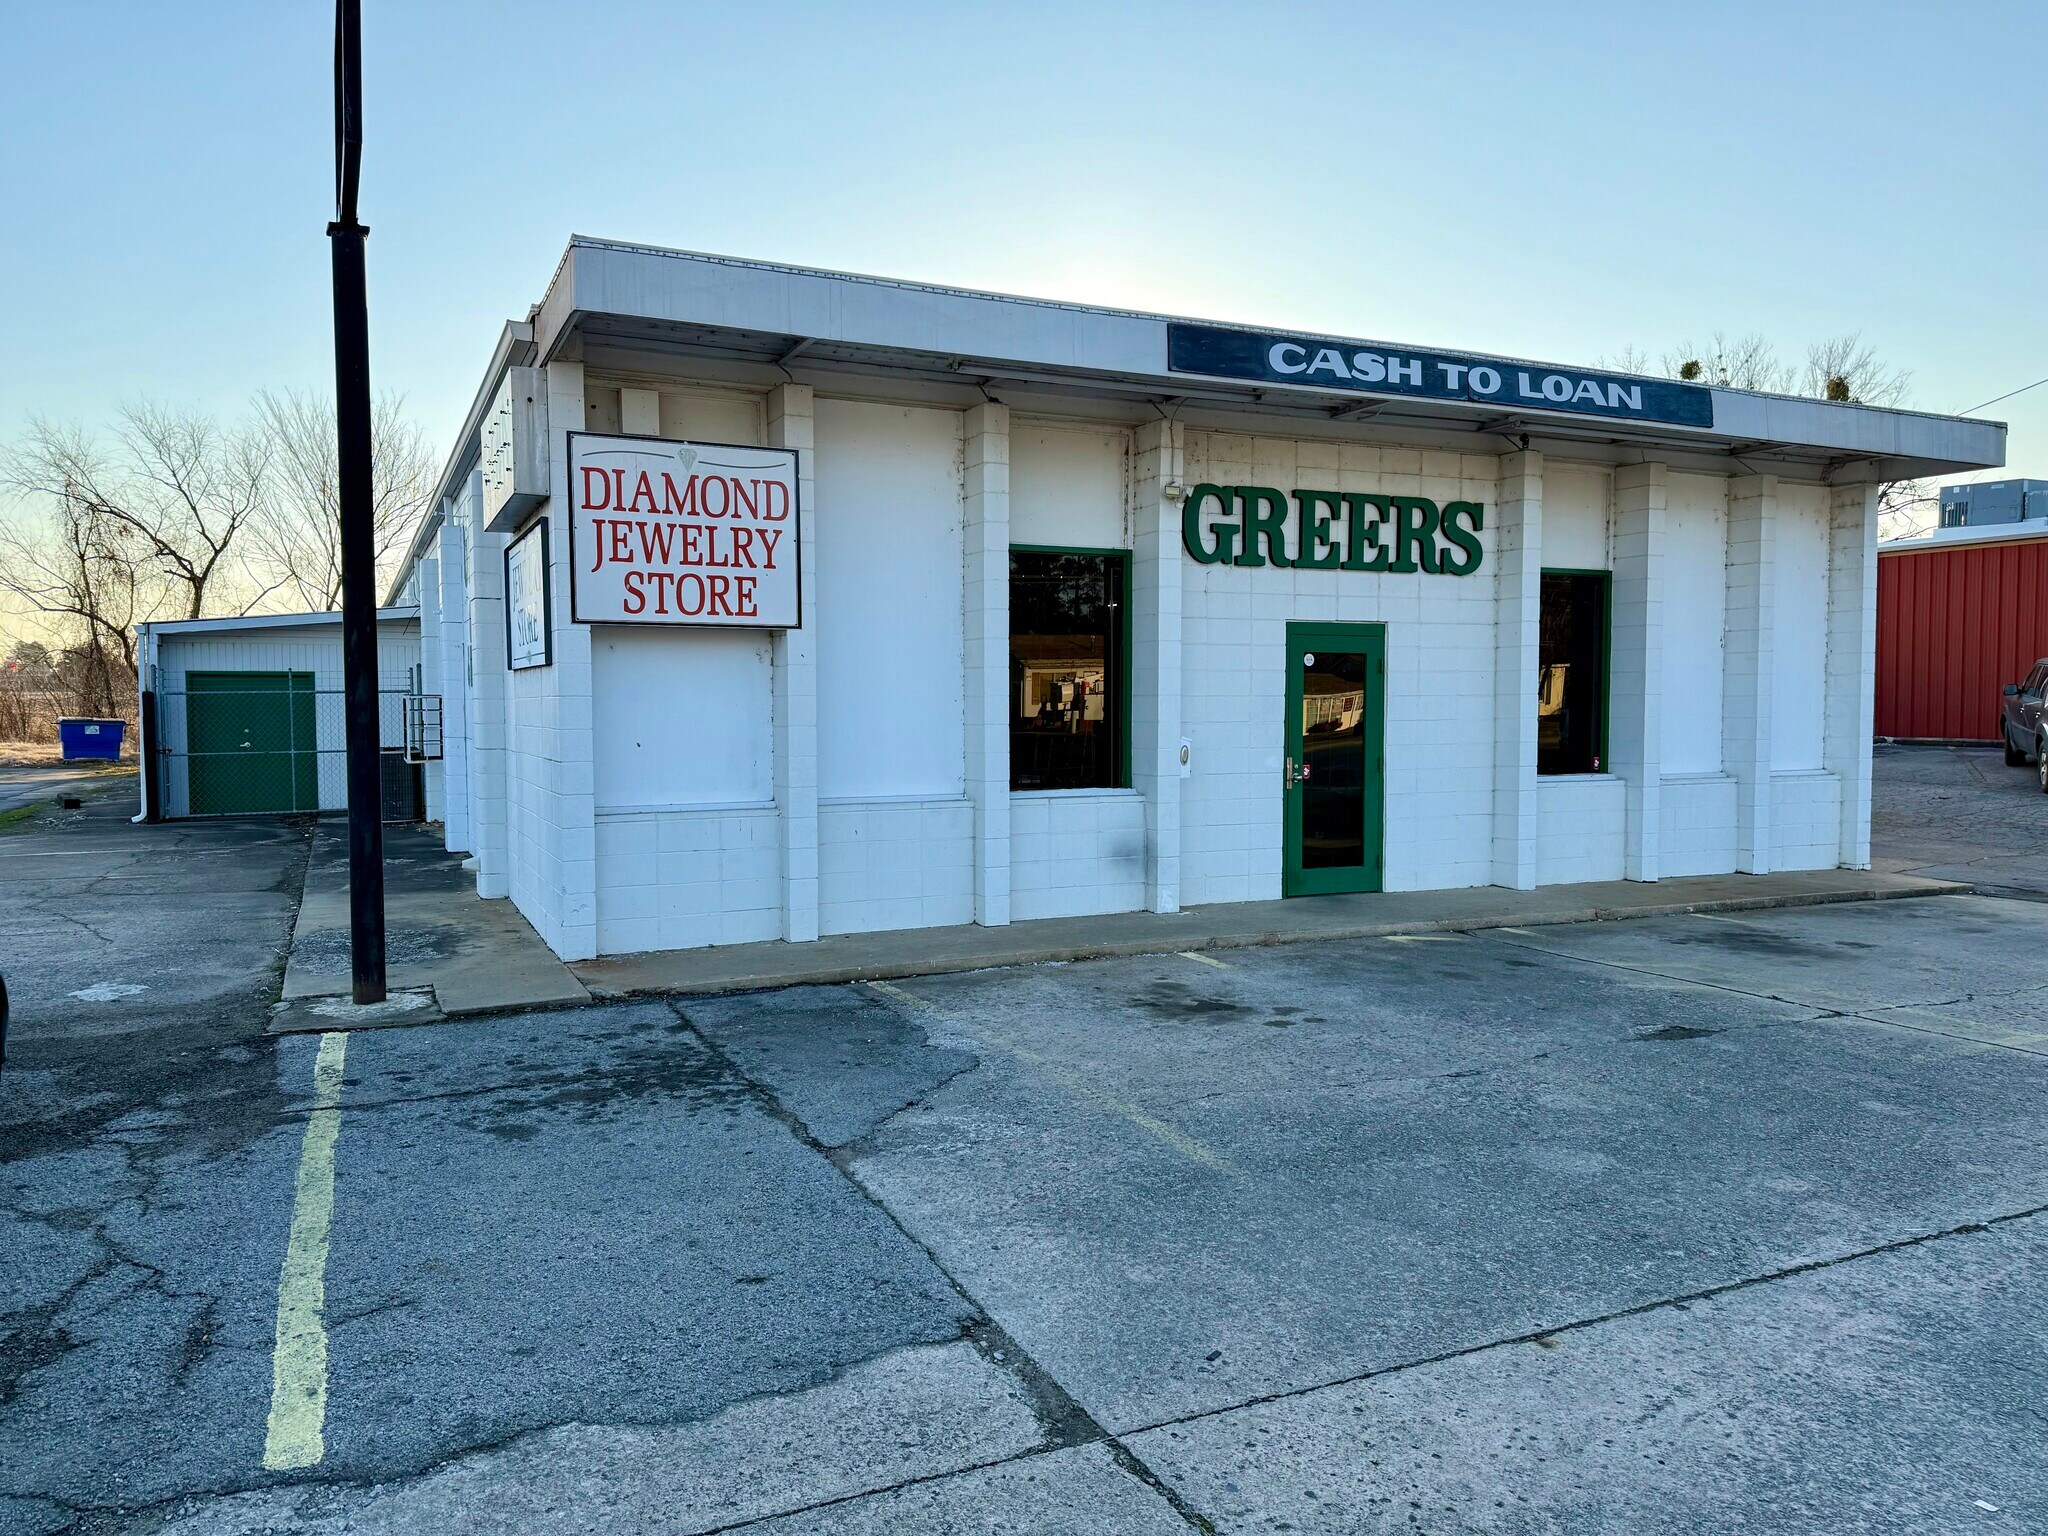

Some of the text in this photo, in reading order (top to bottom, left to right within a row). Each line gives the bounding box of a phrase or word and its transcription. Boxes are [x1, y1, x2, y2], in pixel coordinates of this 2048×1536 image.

[1268, 343, 1642, 410] CASH TO LOAN
[580, 466, 790, 522] DIAMOND
[591, 518, 783, 573] JEWELRY
[1182, 484, 1485, 577] GREERS
[623, 570, 759, 618] STORE
[517, 601, 539, 647] STORE
